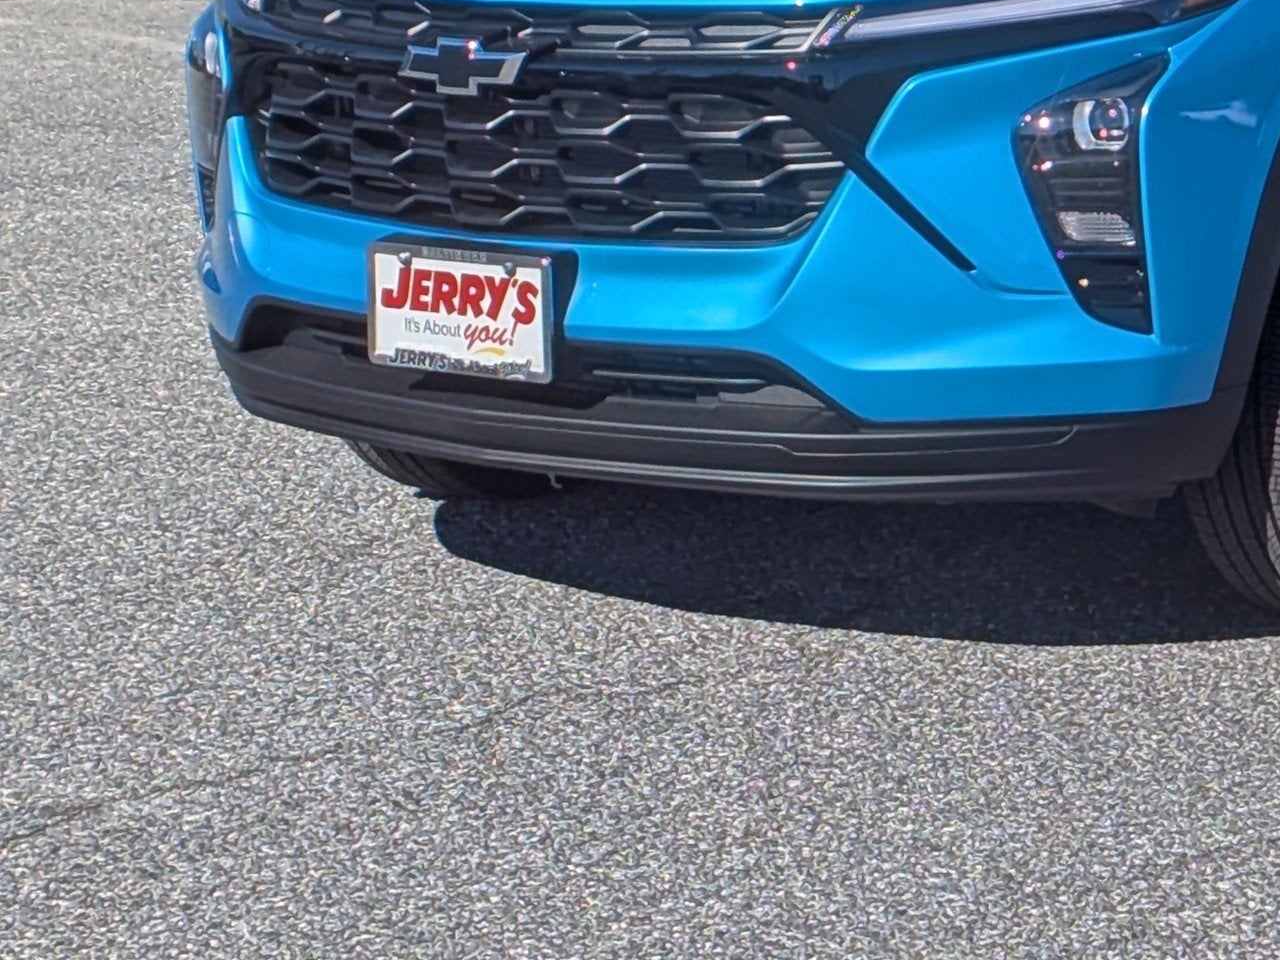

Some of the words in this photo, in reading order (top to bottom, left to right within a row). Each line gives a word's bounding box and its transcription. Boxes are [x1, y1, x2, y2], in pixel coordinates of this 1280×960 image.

[381, 267, 539, 326] JERRY'S
[405, 316, 420, 333] It's
[423, 319, 461, 338] About
[463, 321, 518, 352] you!
[387, 347, 449, 371] JERRY'S
